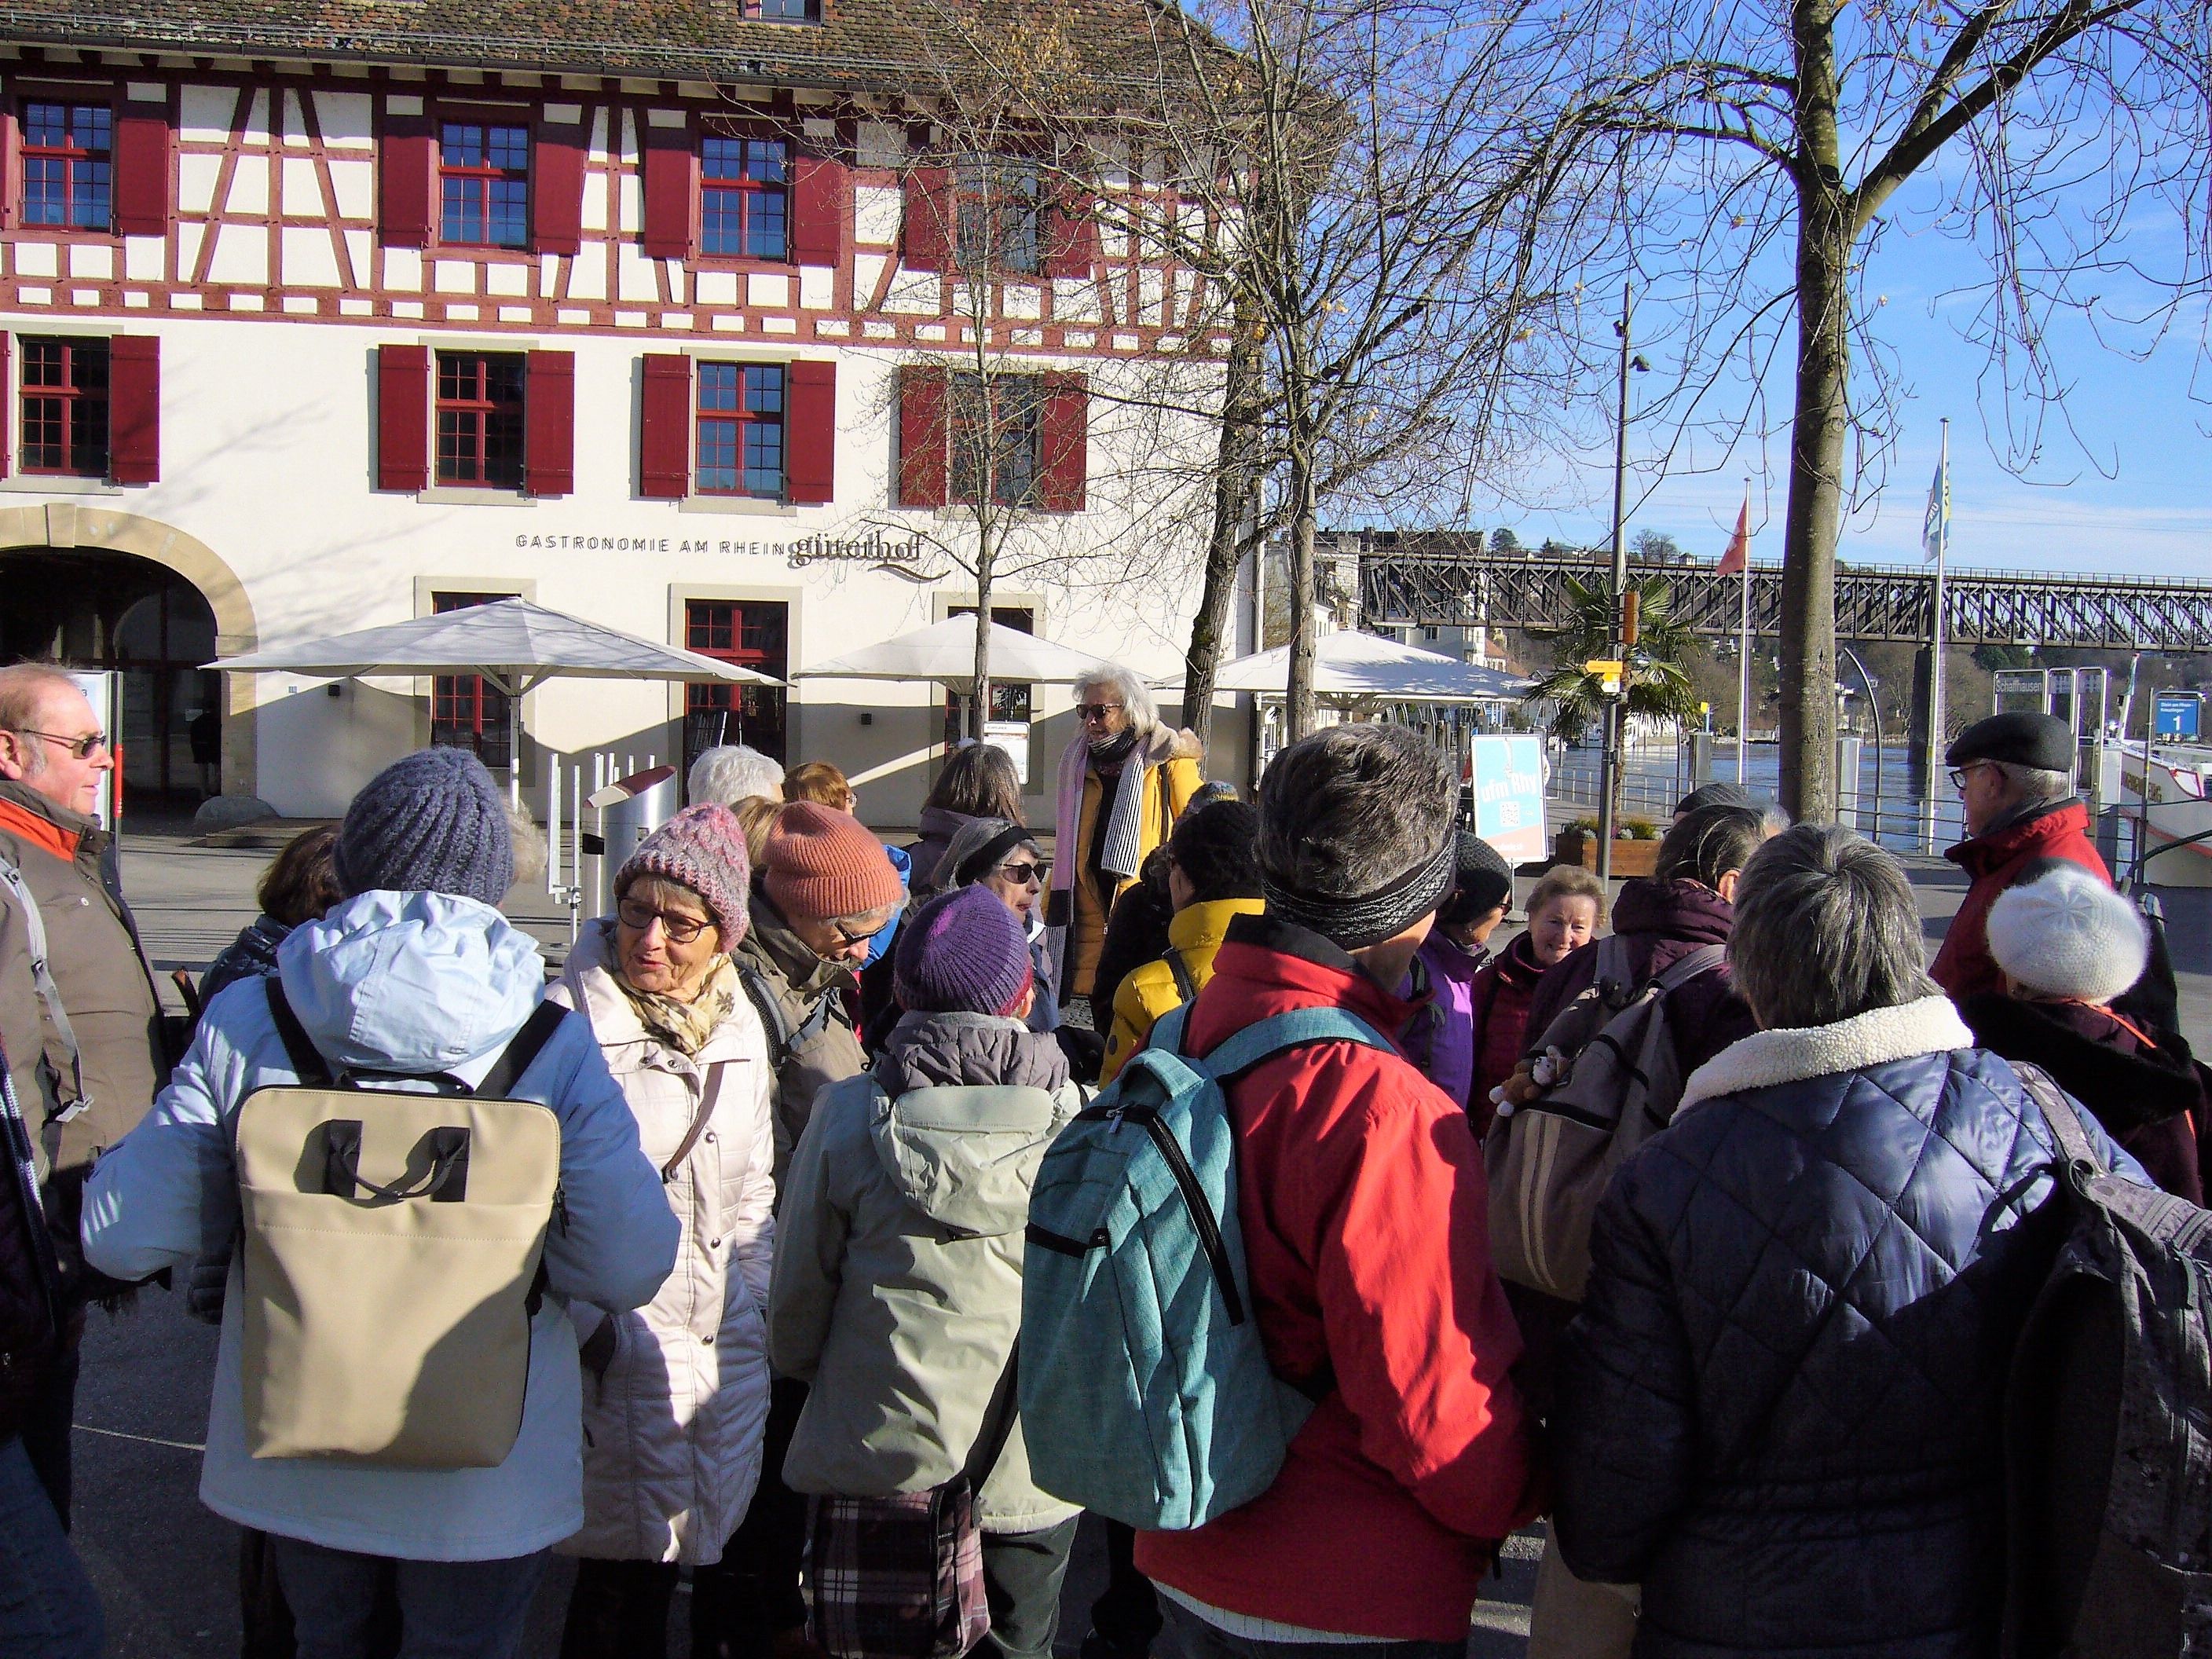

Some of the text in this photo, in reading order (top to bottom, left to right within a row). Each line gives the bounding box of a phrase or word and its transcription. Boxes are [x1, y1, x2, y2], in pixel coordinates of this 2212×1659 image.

[515, 534, 785, 556] GASTRONOMIE AM RHEIN
[792, 530, 926, 566] güterhof
[1995, 679, 2042, 692] Schaffhausen
[2173, 715, 2181, 731] 1
